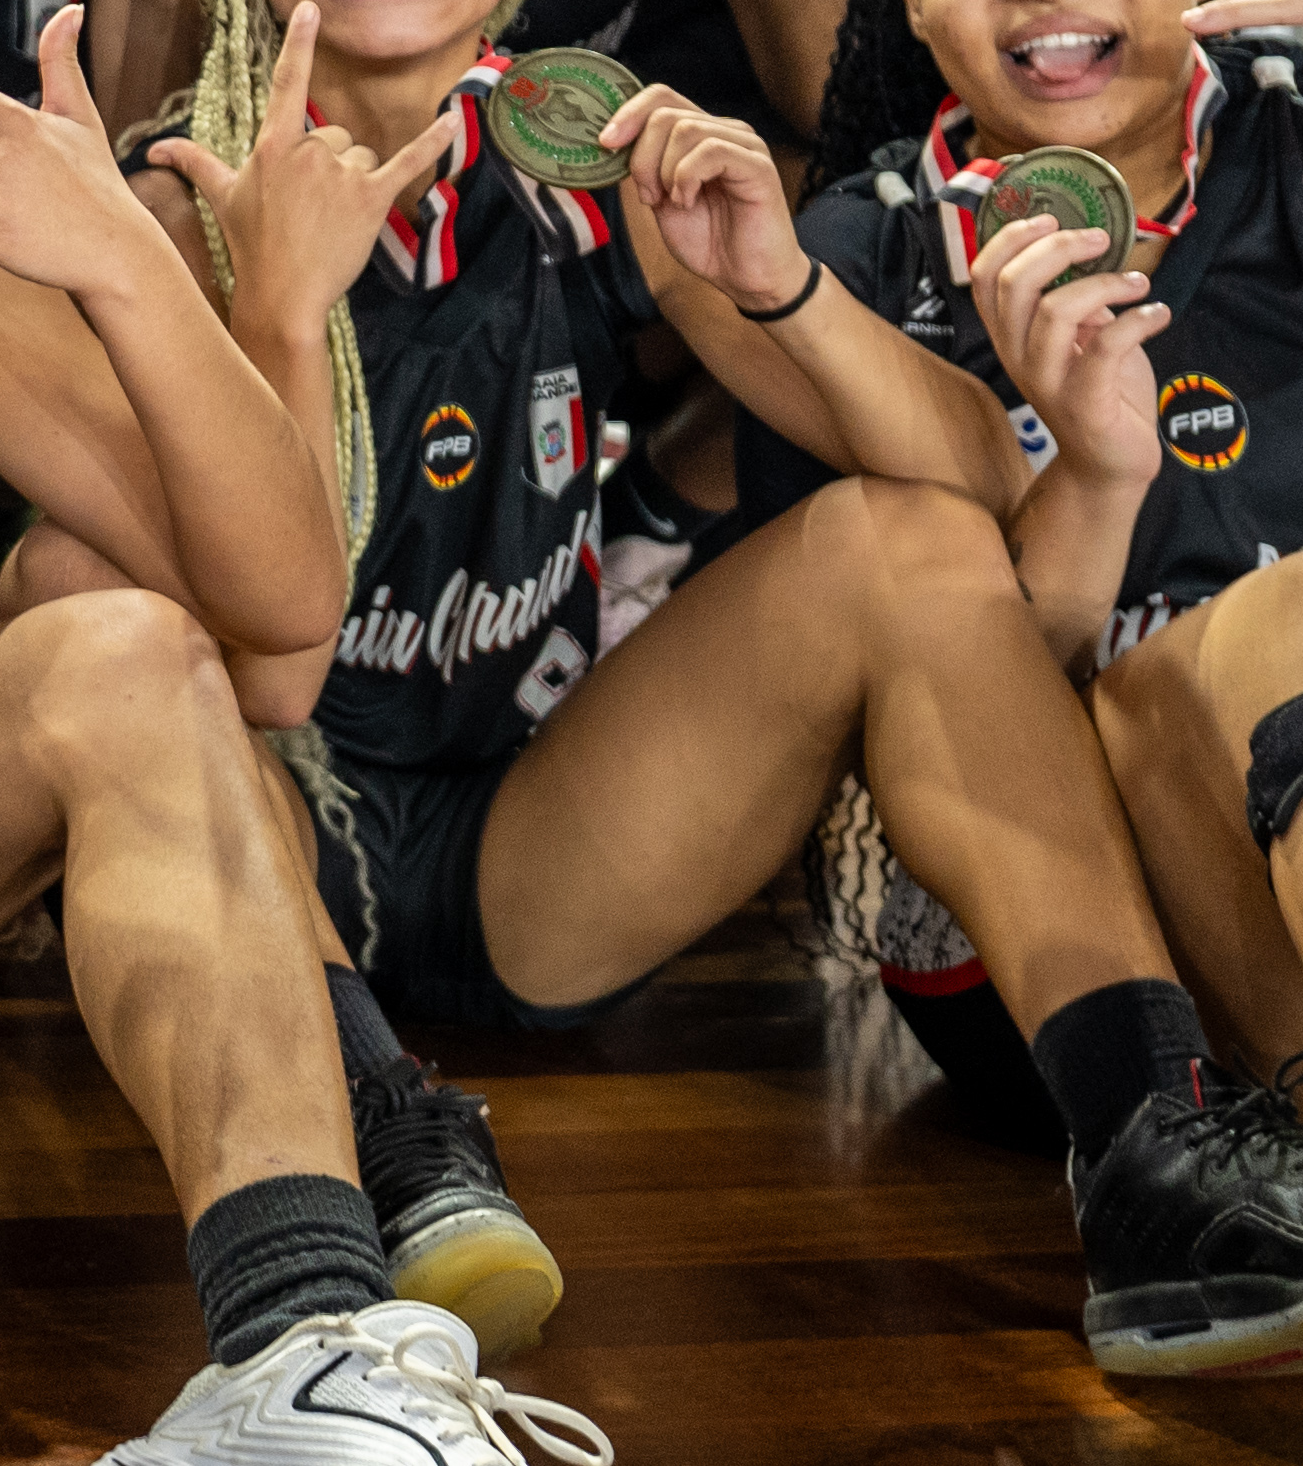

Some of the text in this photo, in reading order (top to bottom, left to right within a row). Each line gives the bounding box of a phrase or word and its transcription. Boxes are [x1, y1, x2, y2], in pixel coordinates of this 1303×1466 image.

[1169, 403, 1235, 440] FPB
[426, 434, 471, 463] FPB
[427, 509, 587, 685] Grand
